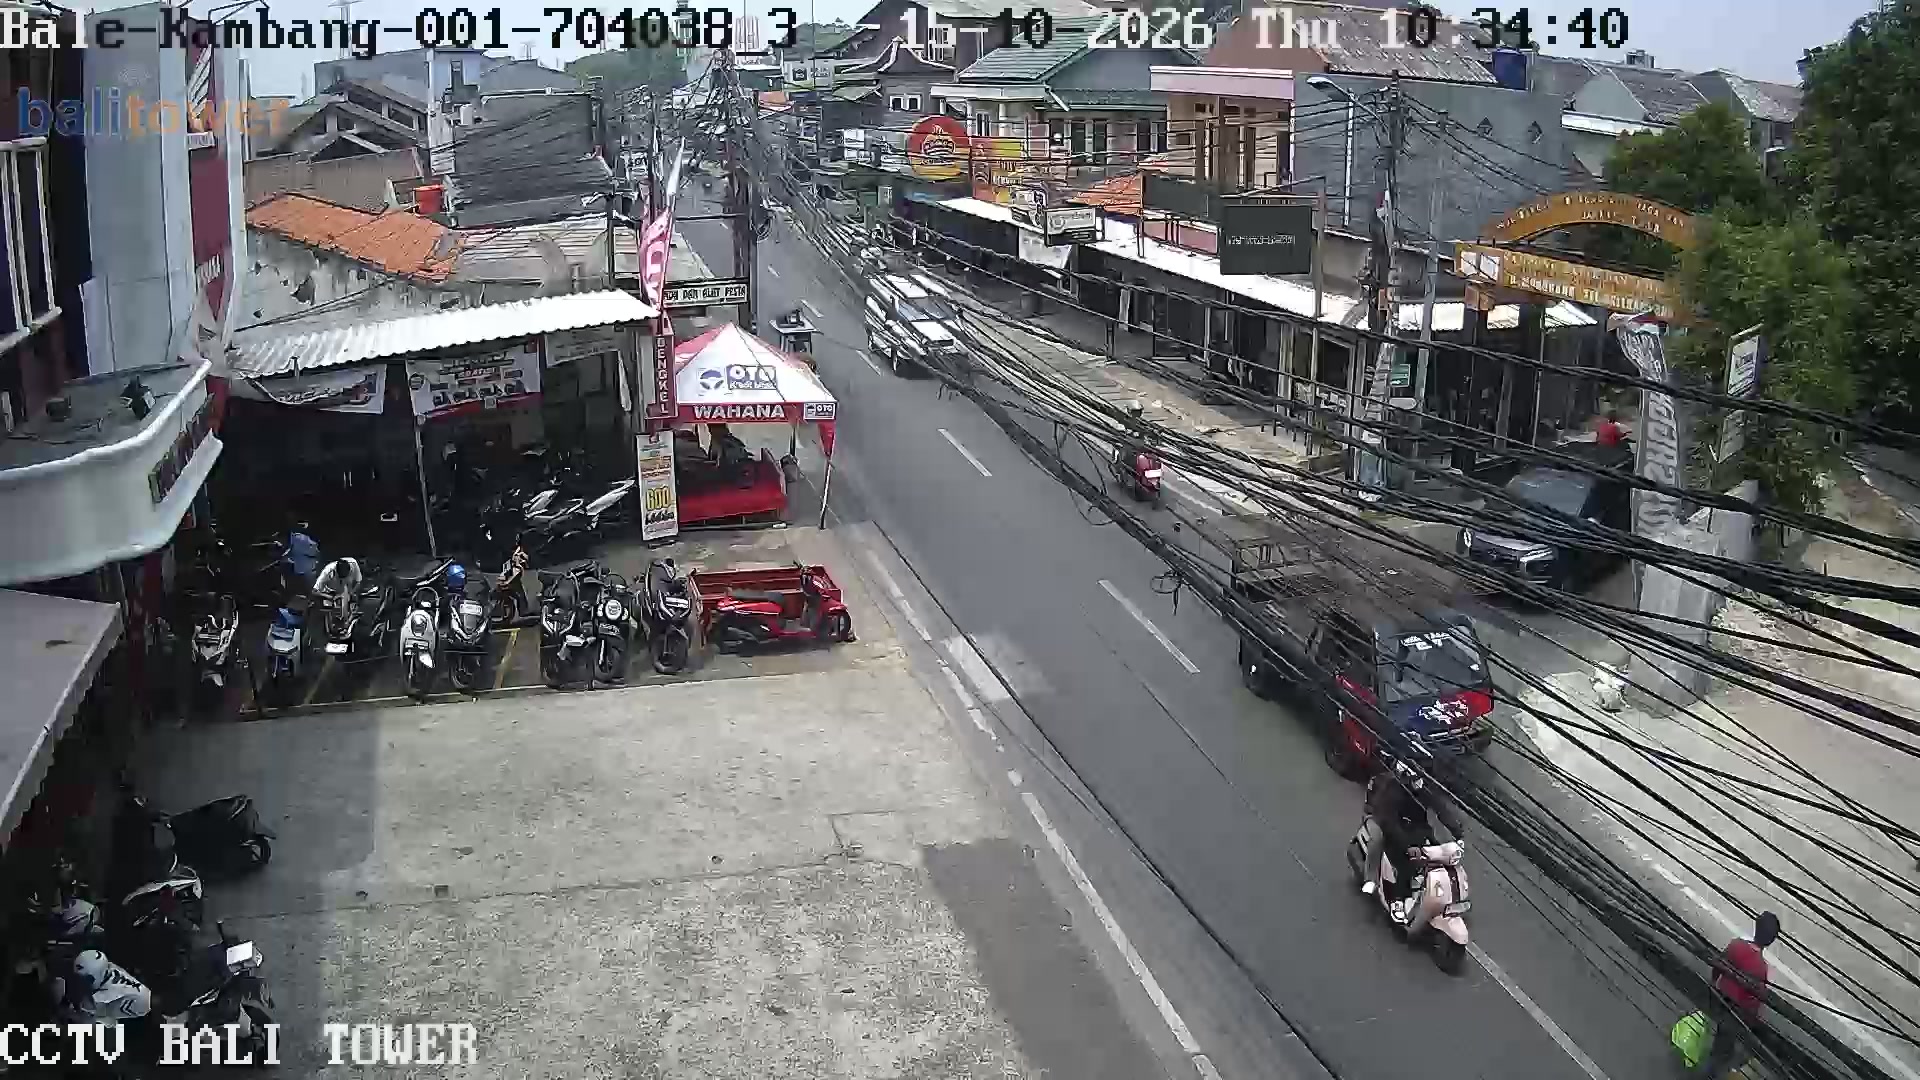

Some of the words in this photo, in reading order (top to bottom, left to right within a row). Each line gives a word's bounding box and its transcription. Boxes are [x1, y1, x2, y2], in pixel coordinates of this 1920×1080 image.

[656, 336, 669, 415] BENGKEL
[729, 365, 776, 381] OTO
[693, 403, 785, 419] WAHANA
